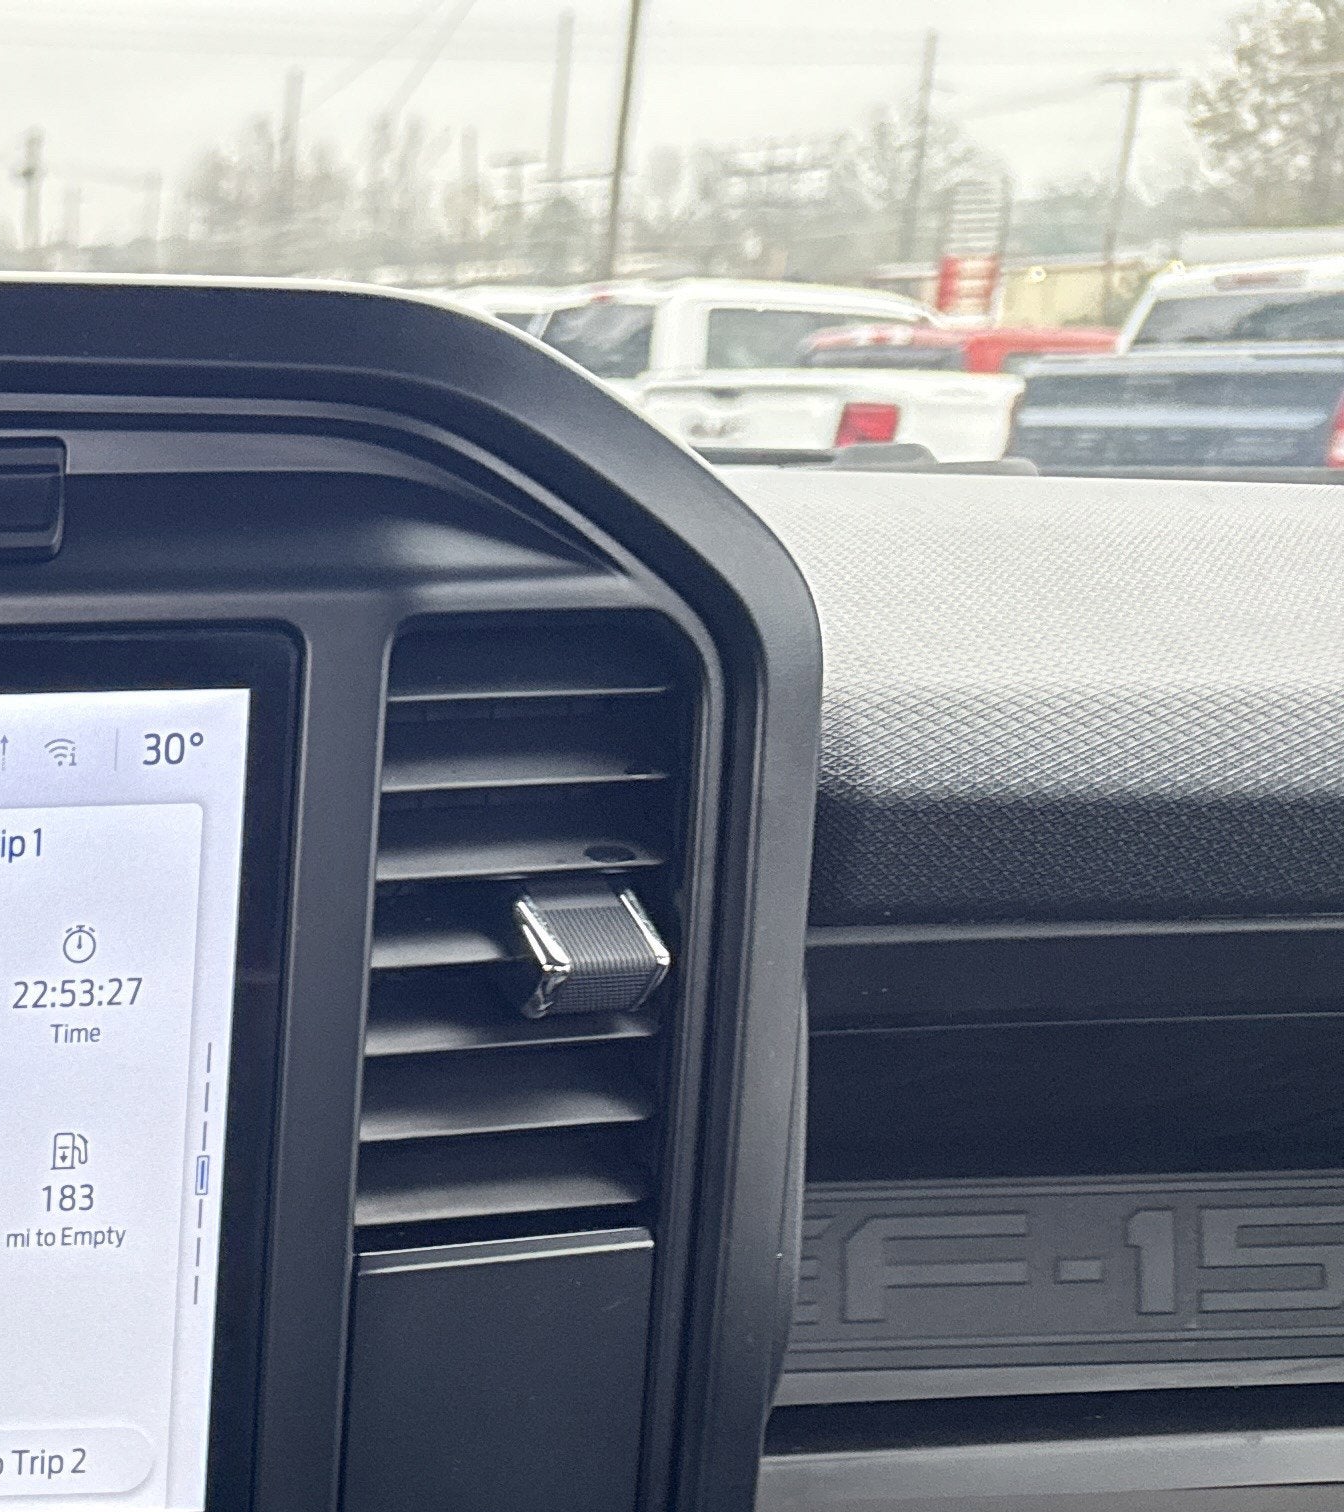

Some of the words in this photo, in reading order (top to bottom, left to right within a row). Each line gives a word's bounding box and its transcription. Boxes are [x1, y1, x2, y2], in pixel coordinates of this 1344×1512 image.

[34, 828, 41, 856] 1
[13, 978, 142, 1009] 22:53:27
[50, 1024, 100, 1043] Time
[42, 1184, 93, 1211] 183
[7, 1229, 30, 1247] mi
[36, 1229, 55, 1246] to
[61, 1227, 126, 1248] Empty
[12, 1450, 63, 1479] Trip
[71, 1448, 86, 1473] 2
